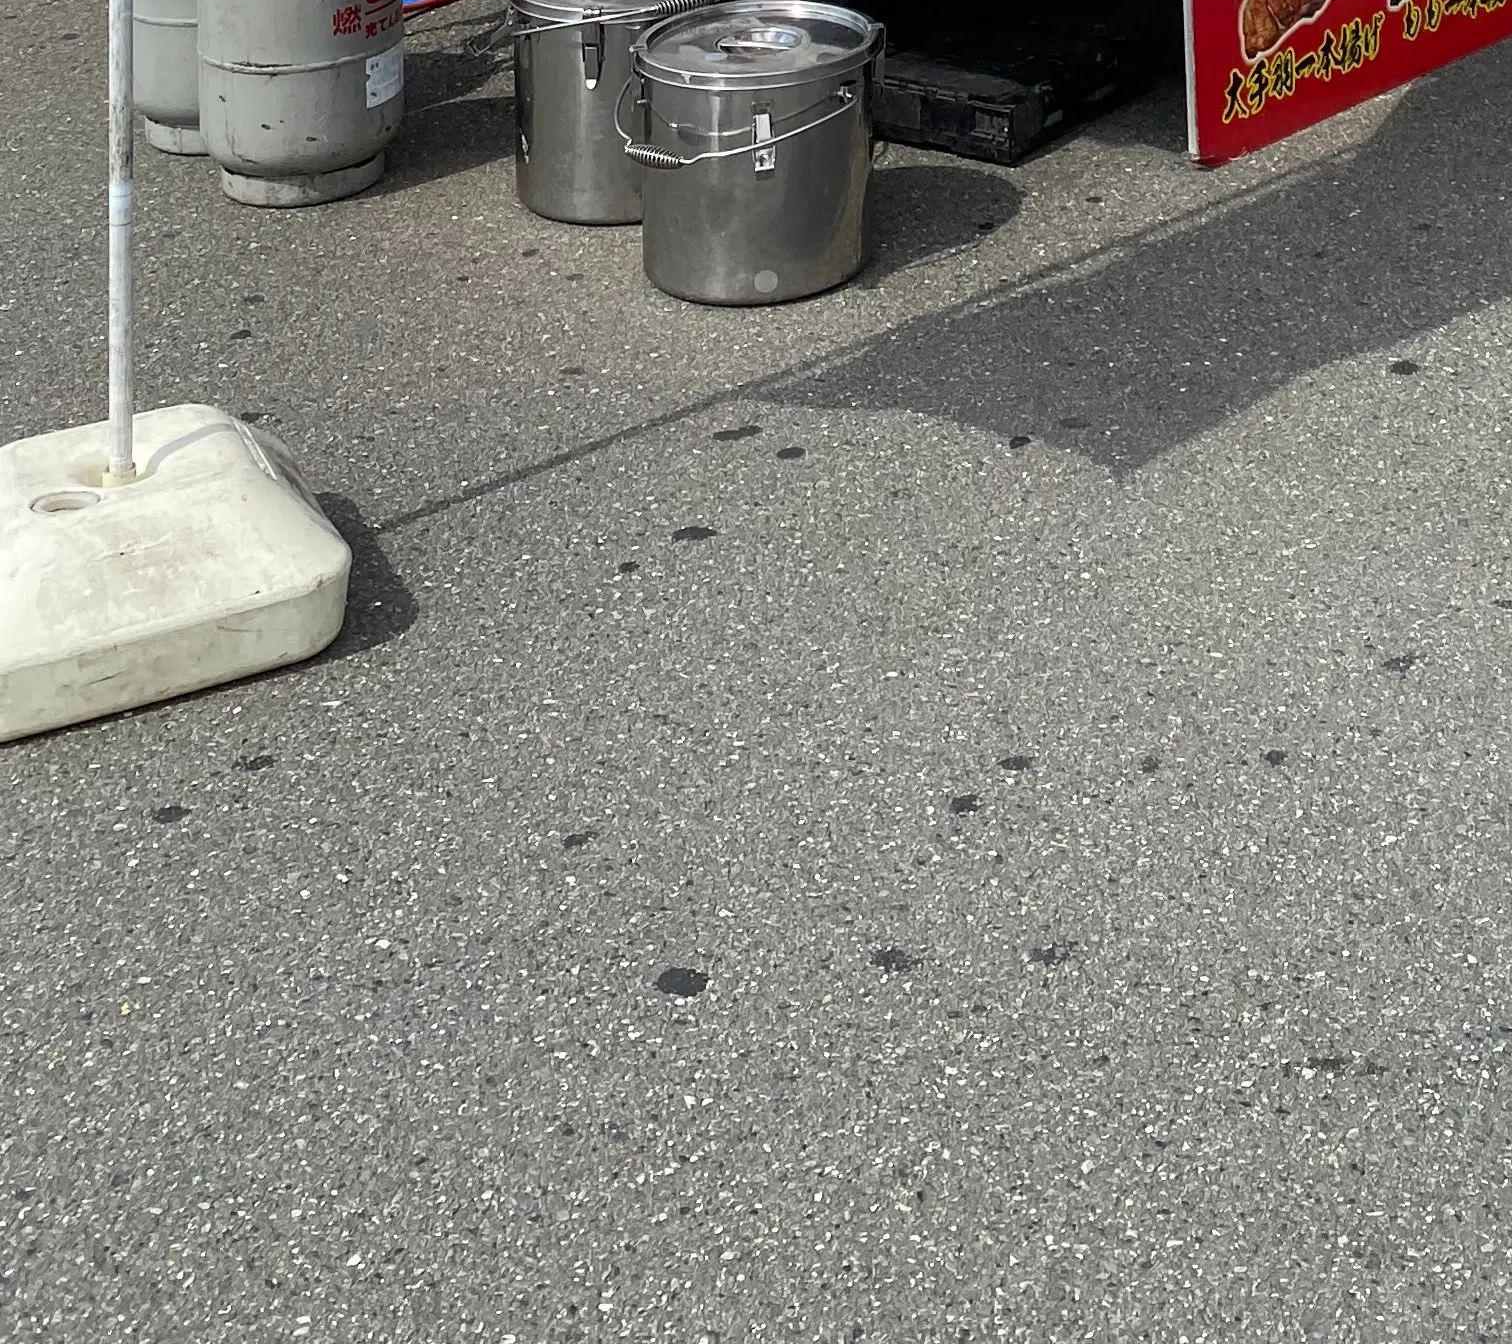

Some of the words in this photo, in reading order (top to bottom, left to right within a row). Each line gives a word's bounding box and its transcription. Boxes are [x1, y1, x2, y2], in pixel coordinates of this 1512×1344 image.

[333, 4, 362, 36] 燃
[1222, 13, 1386, 124] 大手羽一本揚げ
